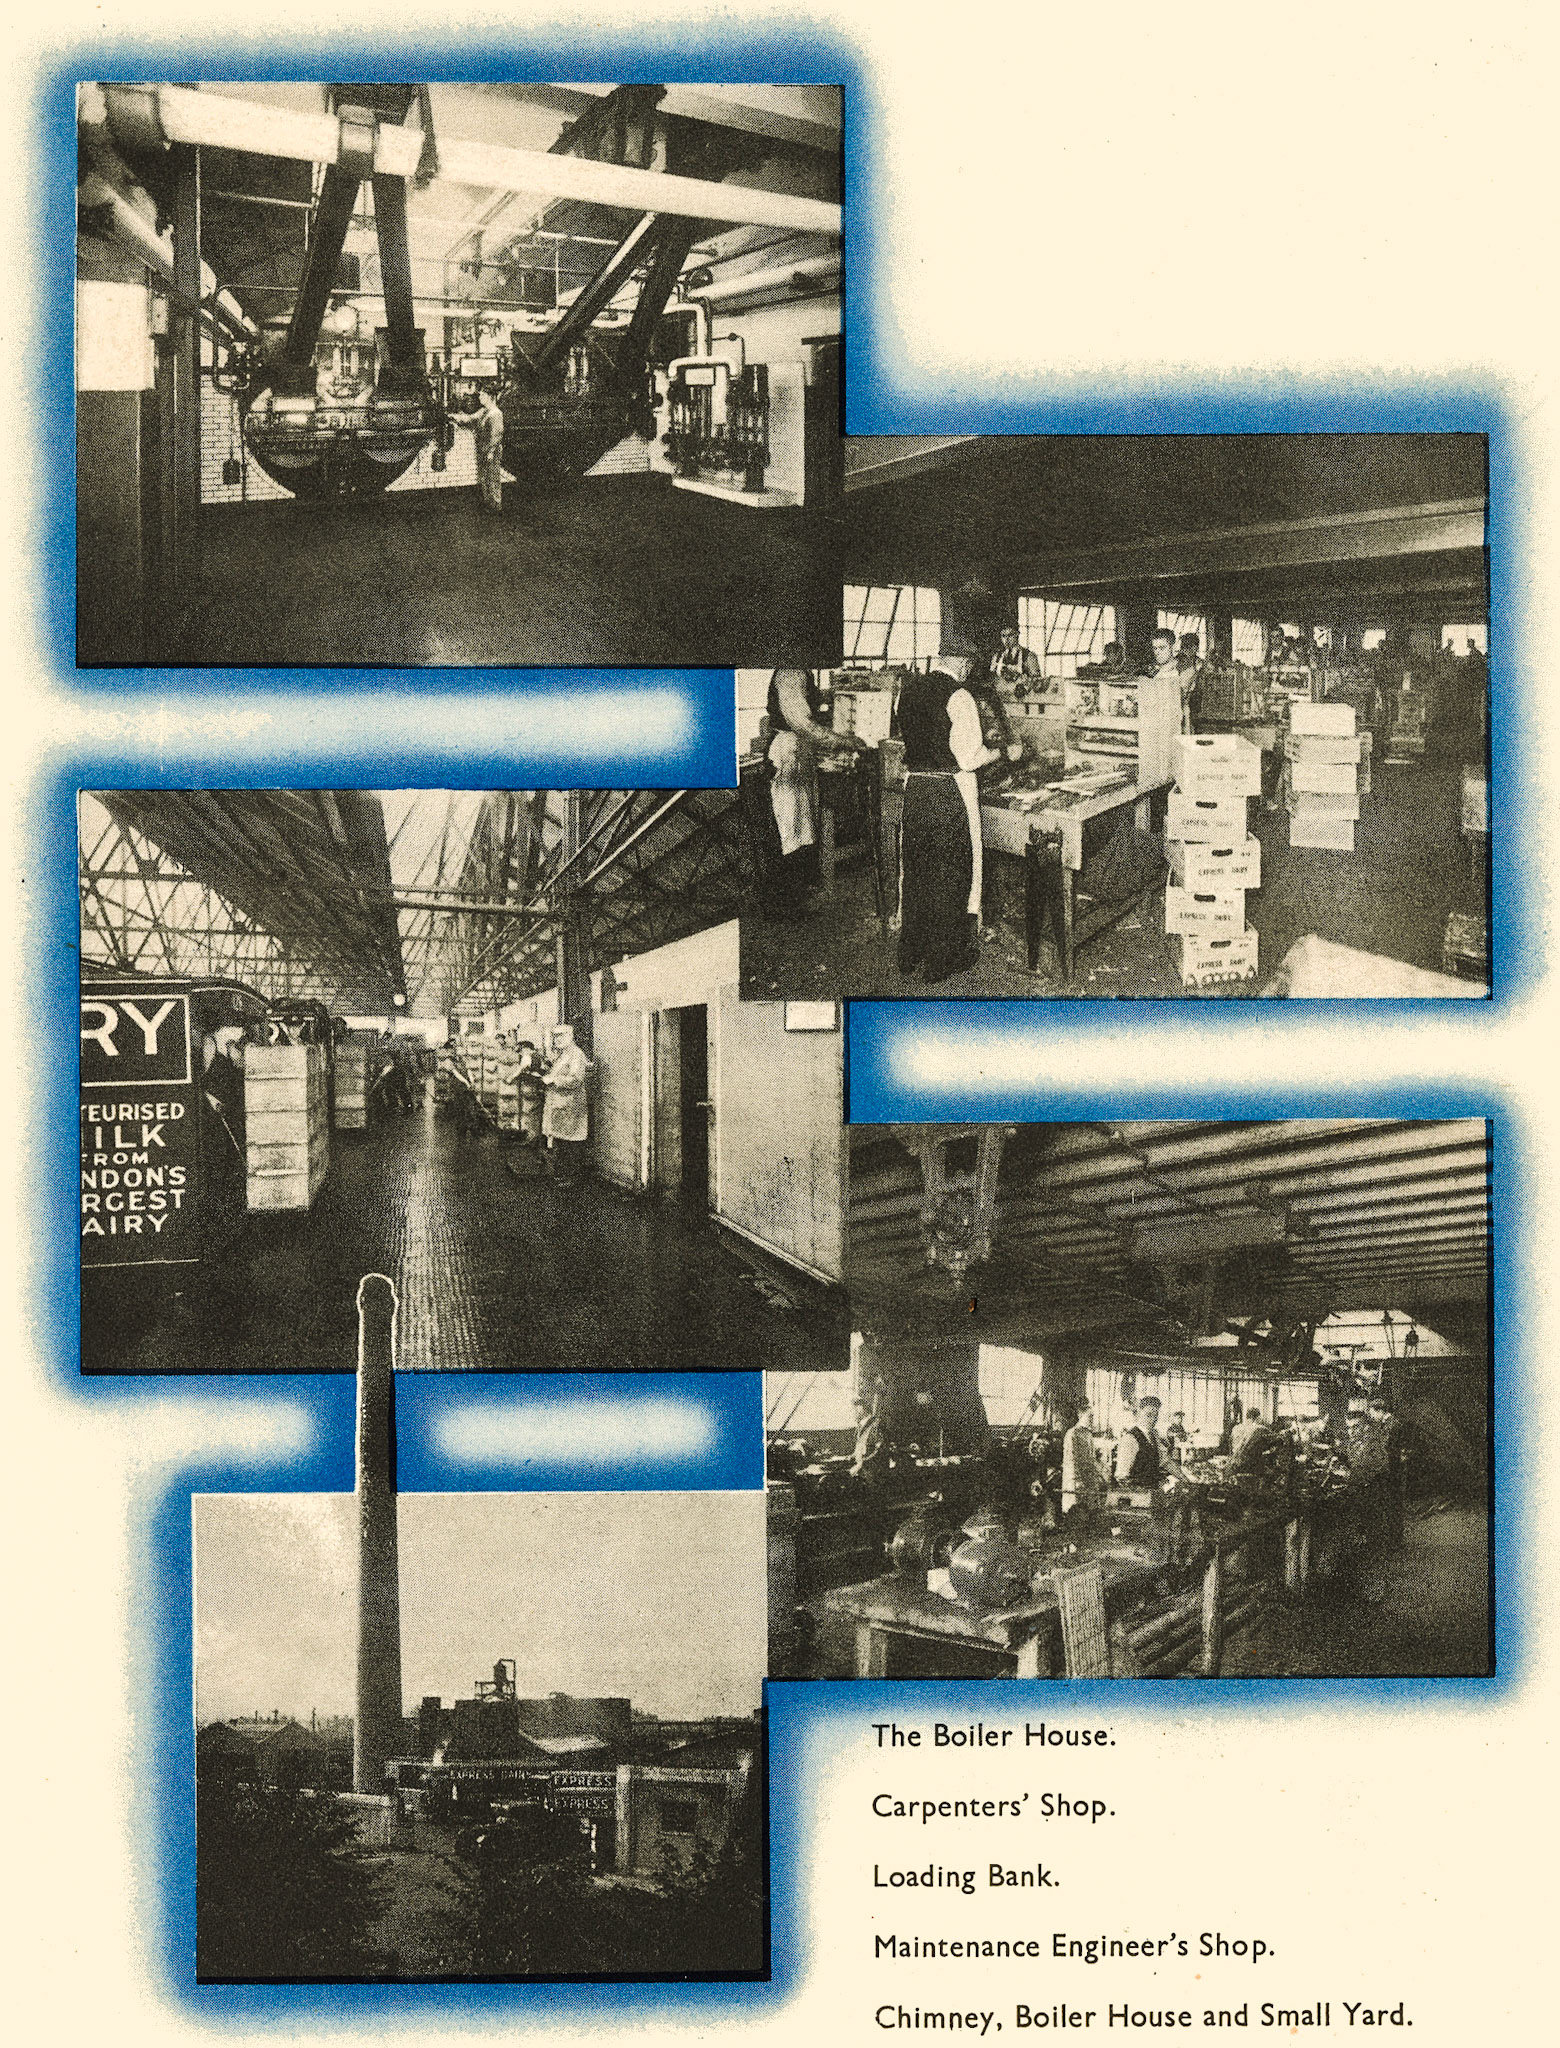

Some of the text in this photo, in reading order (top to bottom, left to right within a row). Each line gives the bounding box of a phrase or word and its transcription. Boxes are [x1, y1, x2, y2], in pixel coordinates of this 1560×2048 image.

[81, 1188, 187, 1213] RGEST
[81, 1213, 170, 1237] AIRY
[871, 1722, 1117, 1748] The Boiler House.
[552, 1775, 613, 1787] EXPRESS
[872, 1793, 1116, 1825] Carpenters’ Shop.
[874, 1863, 1060, 1895] Loading Bank.
[875, 1932, 1275, 1964] Maintenance Engineer’s Shop.
[875, 2002, 1414, 2036] Chimney, Boiler House and Small Yard.
